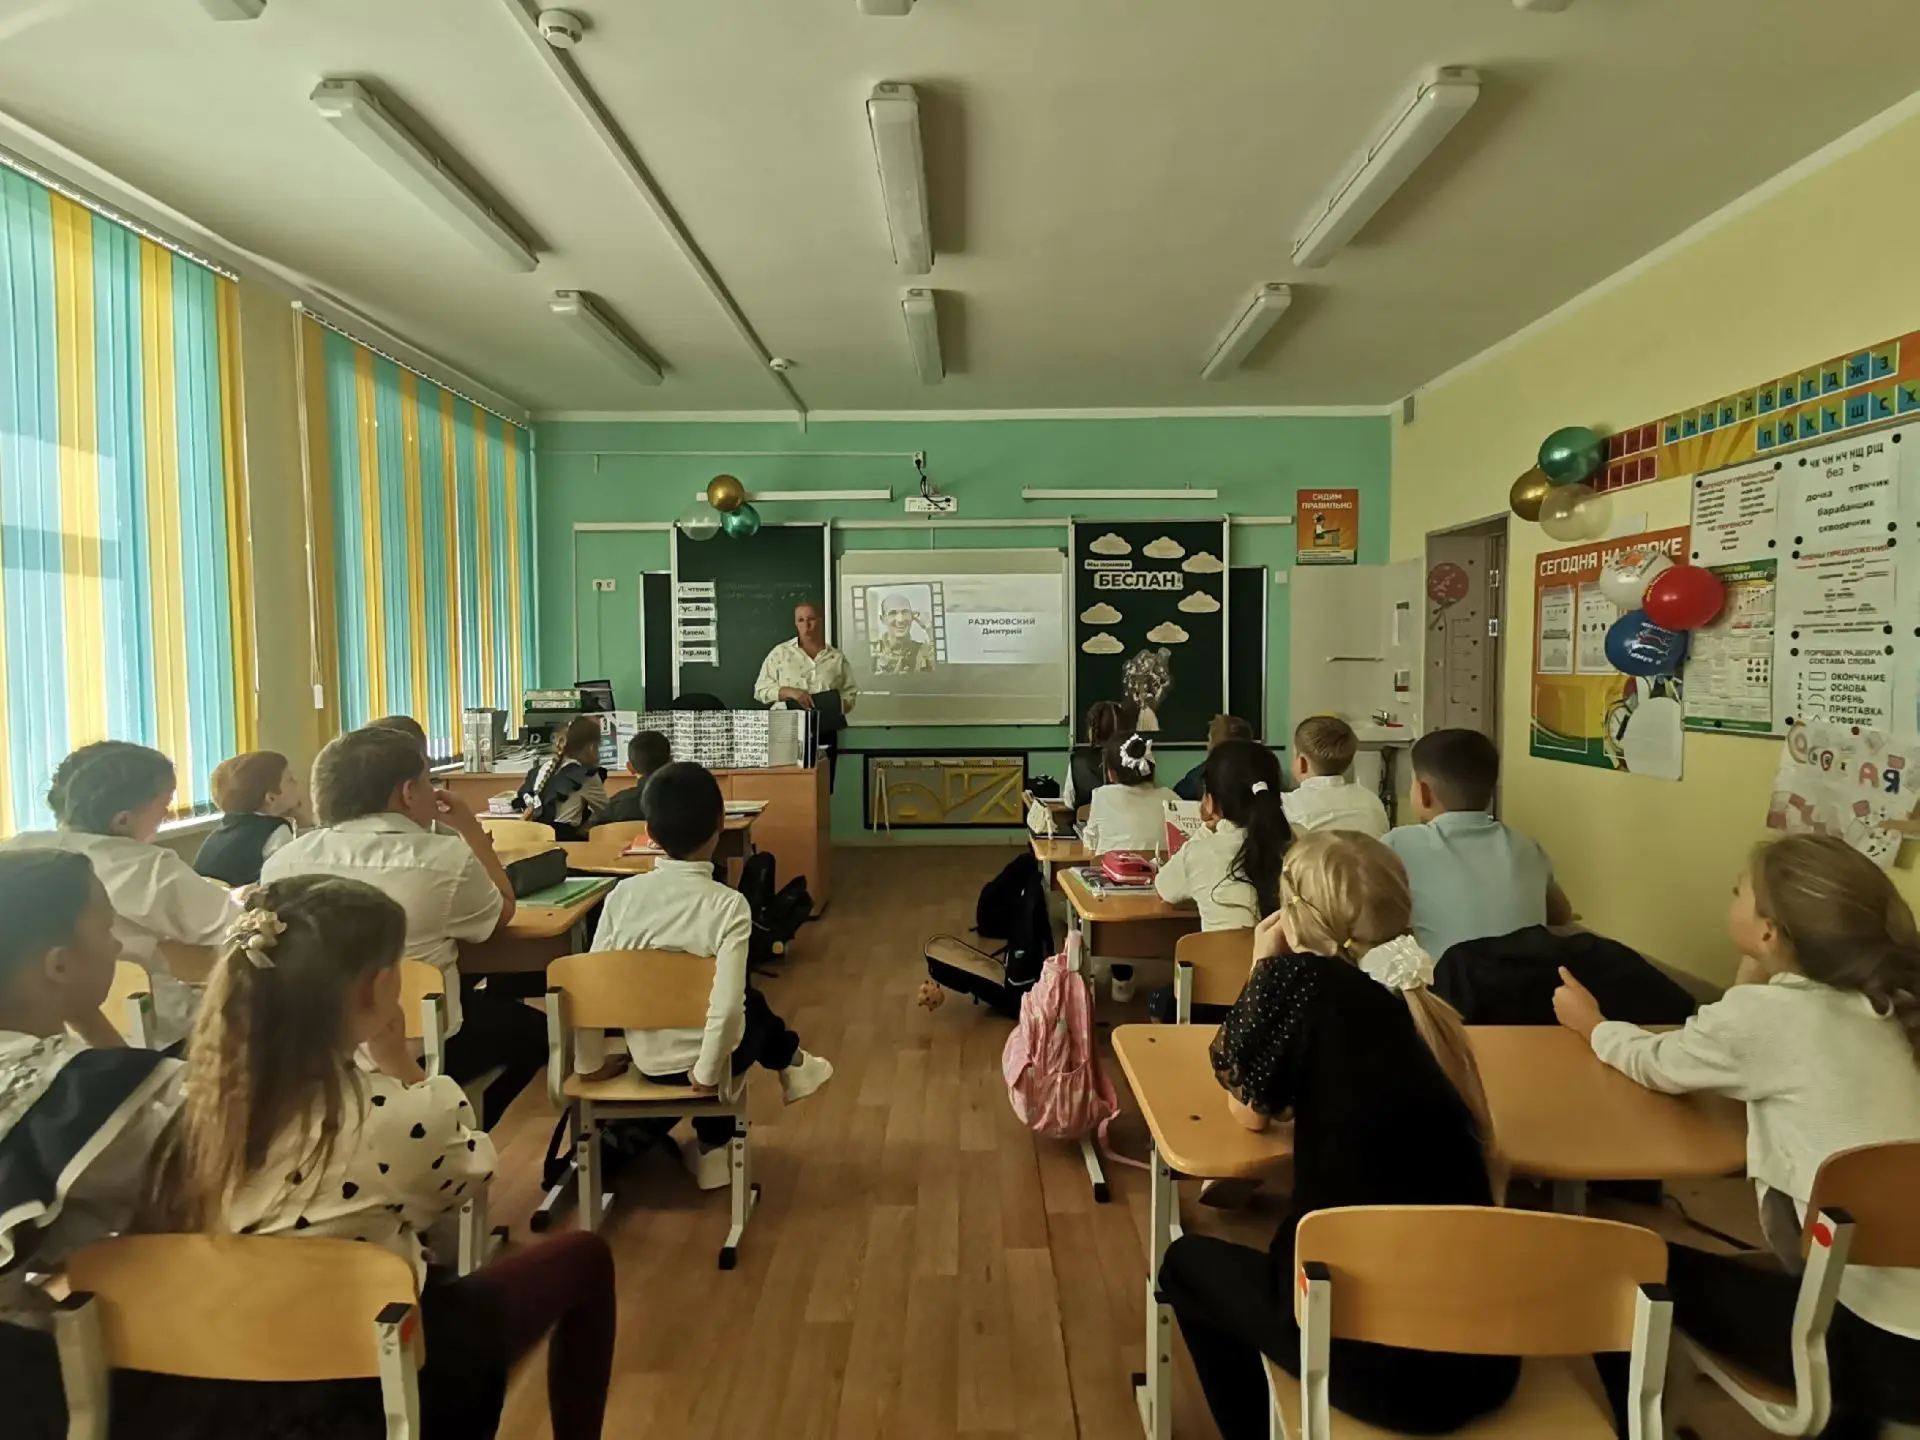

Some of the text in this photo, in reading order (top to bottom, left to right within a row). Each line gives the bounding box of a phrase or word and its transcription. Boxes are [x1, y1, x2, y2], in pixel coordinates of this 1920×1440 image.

[1826, 467, 1844, 479] без
[1312, 493, 1343, 501] СИДИМ
[1805, 490, 1833, 503] дочка
[1301, 502, 1353, 510] ПРАВИЛЬНО
[1540, 552, 1598, 577] СЕГОДНЯ
[968, 618, 1036, 626] РАЗУМОВСКИЙ
[982, 628, 1022, 636] Дмитрий
[1831, 672, 1887, 683] ОКОНЧАНИЕ
[1830, 683, 1867, 692] ОСНОВА
[1829, 694, 1865, 704] КОРЕНЬ
[1829, 704, 1883, 716] ПРИСТАВКА
[1829, 715, 1873, 727] СУФФИКС
